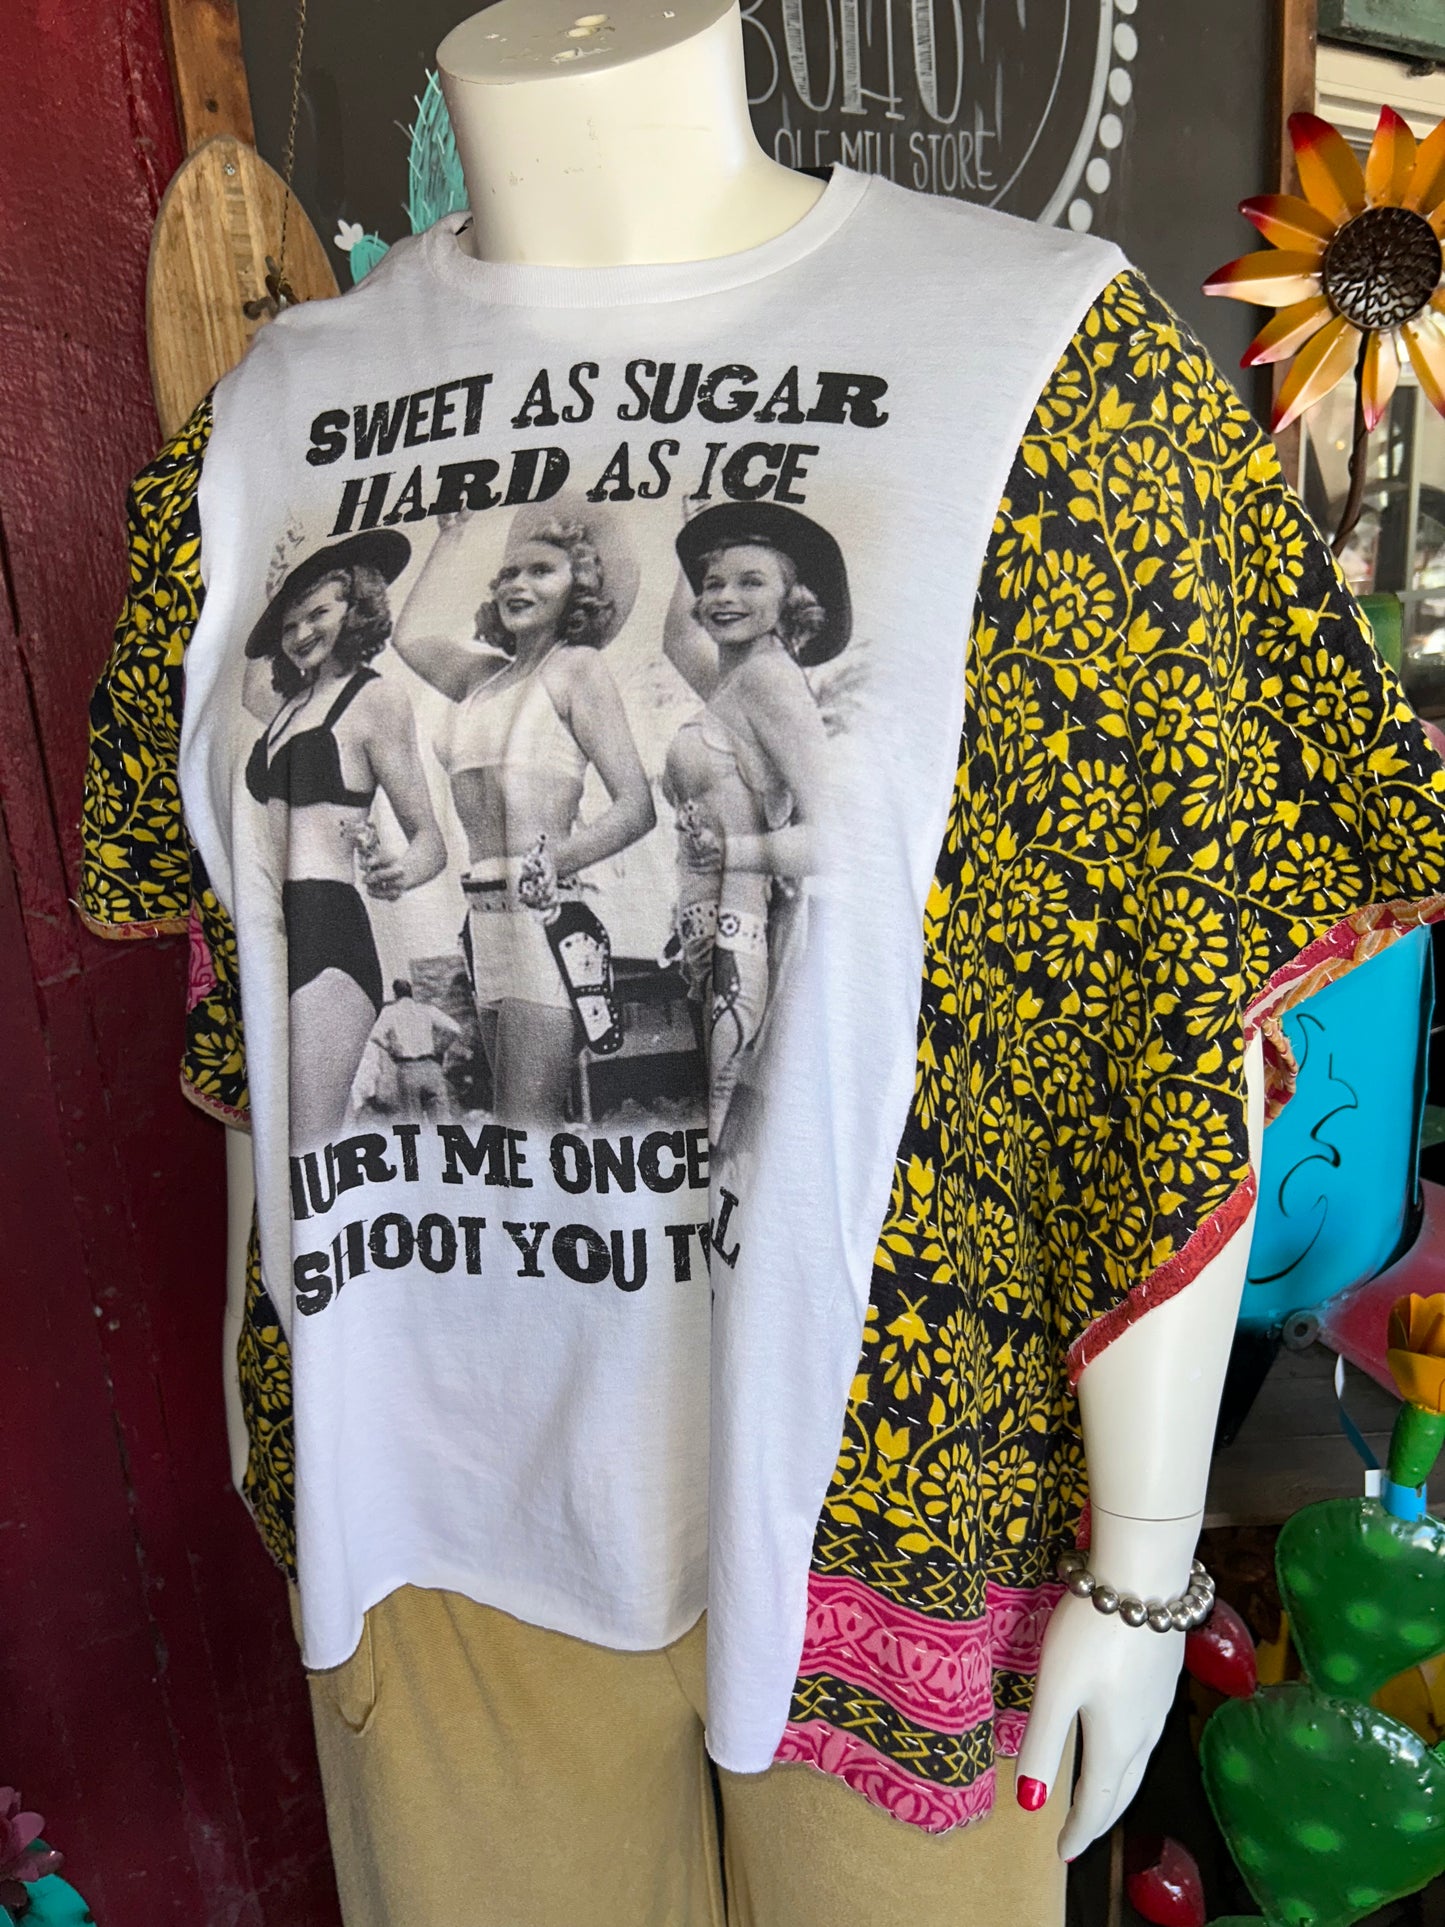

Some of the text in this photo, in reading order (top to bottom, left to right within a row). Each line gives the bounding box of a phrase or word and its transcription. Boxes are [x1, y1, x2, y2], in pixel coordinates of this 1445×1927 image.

[909, 130, 997, 193] STORE
[305, 359, 889, 467] SWEET AS SUGAR
[326, 438, 819, 538] HARD AS ICE
[436, 1124, 534, 1188] ME
[549, 1128, 711, 1194] ONCE
[294, 1213, 487, 1317] SHOOT
[502, 1221, 648, 1292] YOU
